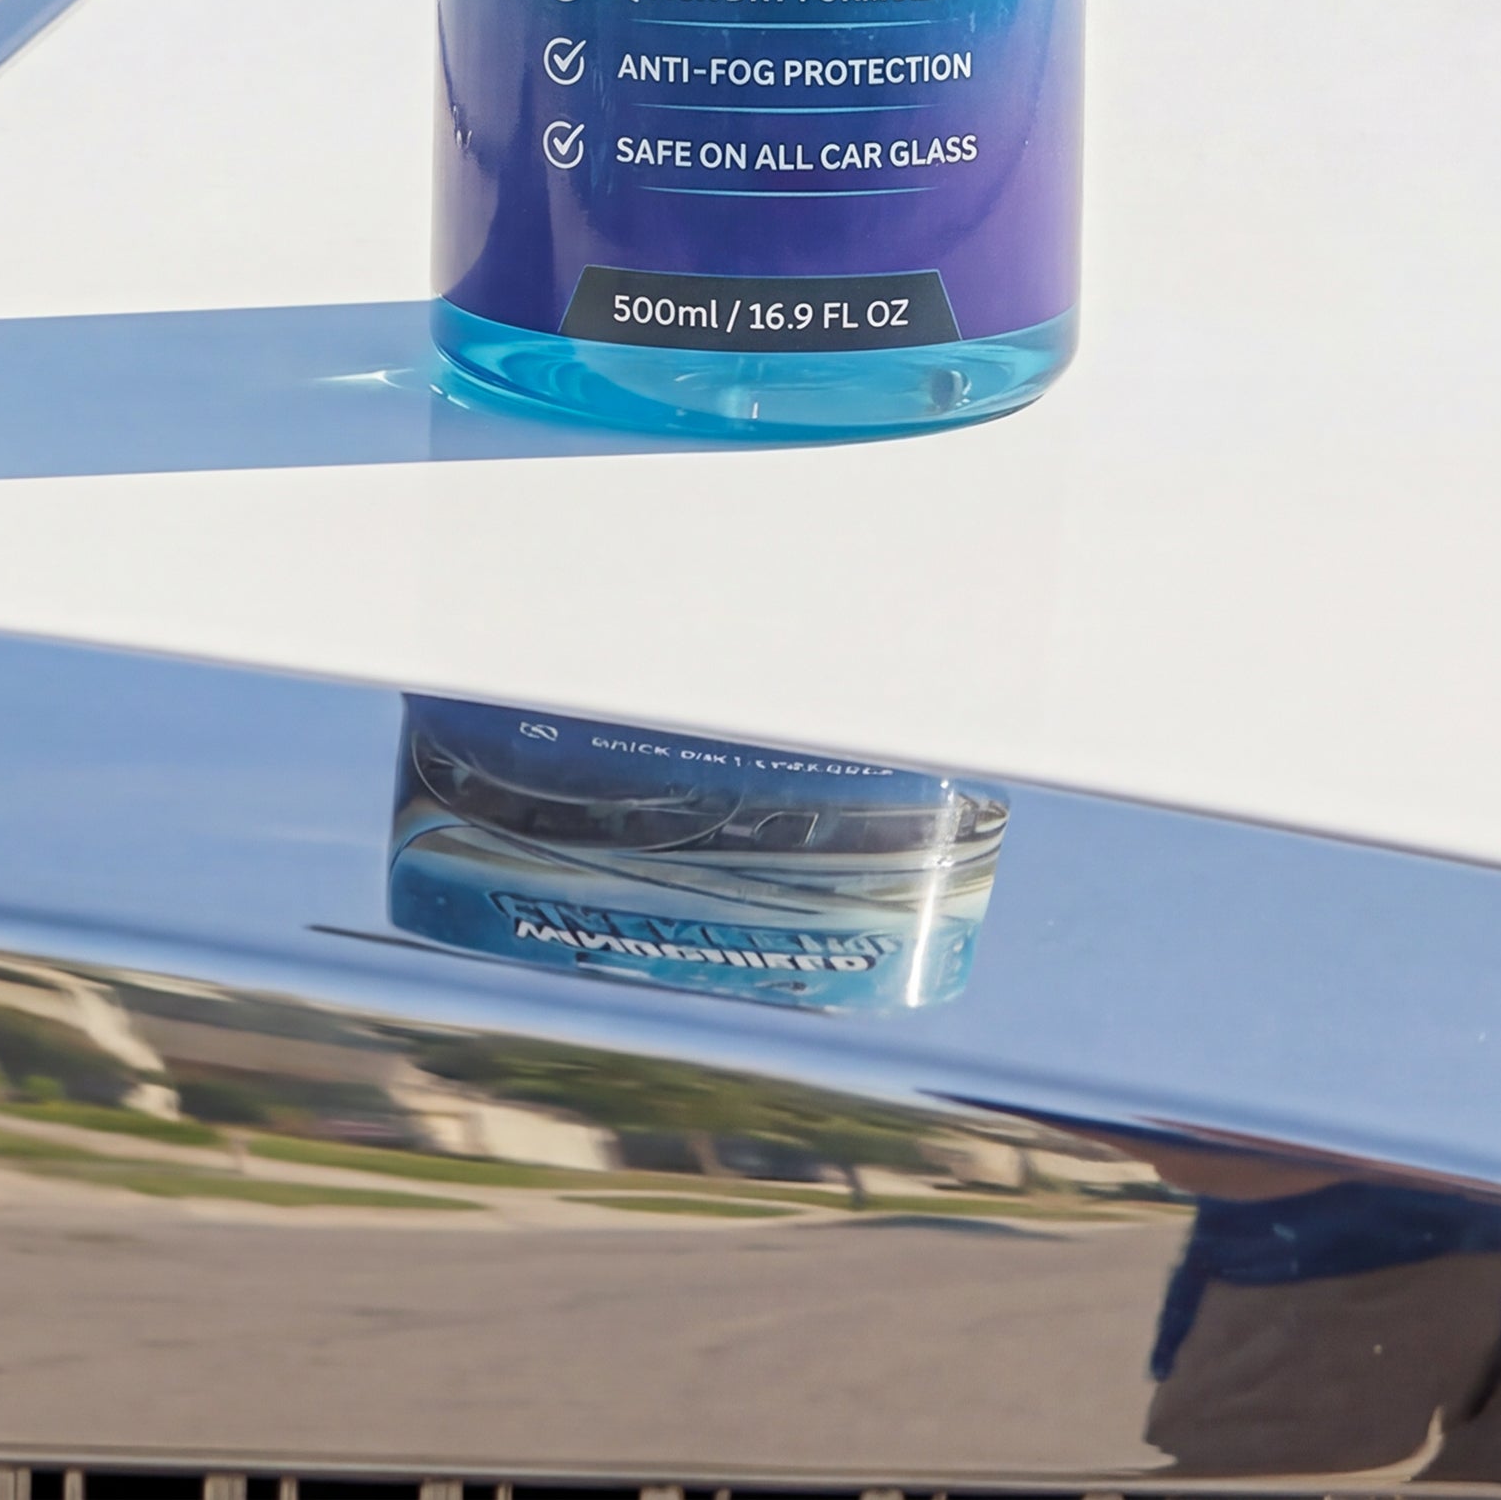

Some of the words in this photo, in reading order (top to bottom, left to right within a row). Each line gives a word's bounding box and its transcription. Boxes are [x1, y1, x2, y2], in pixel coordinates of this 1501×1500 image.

[616, 53, 776, 87] ANTI-FOG
[783, 51, 973, 87] PROTECTION
[615, 136, 693, 168] SAFE
[699, 141, 747, 171] ON
[754, 143, 814, 171] ALL
[819, 141, 883, 171] CAR
[888, 134, 979, 168] GLASS
[612, 293, 720, 330] 500ml
[725, 299, 742, 334] /
[748, 301, 814, 331] 16.9
[822, 301, 859, 330] FL
[865, 298, 910, 329] OZ
